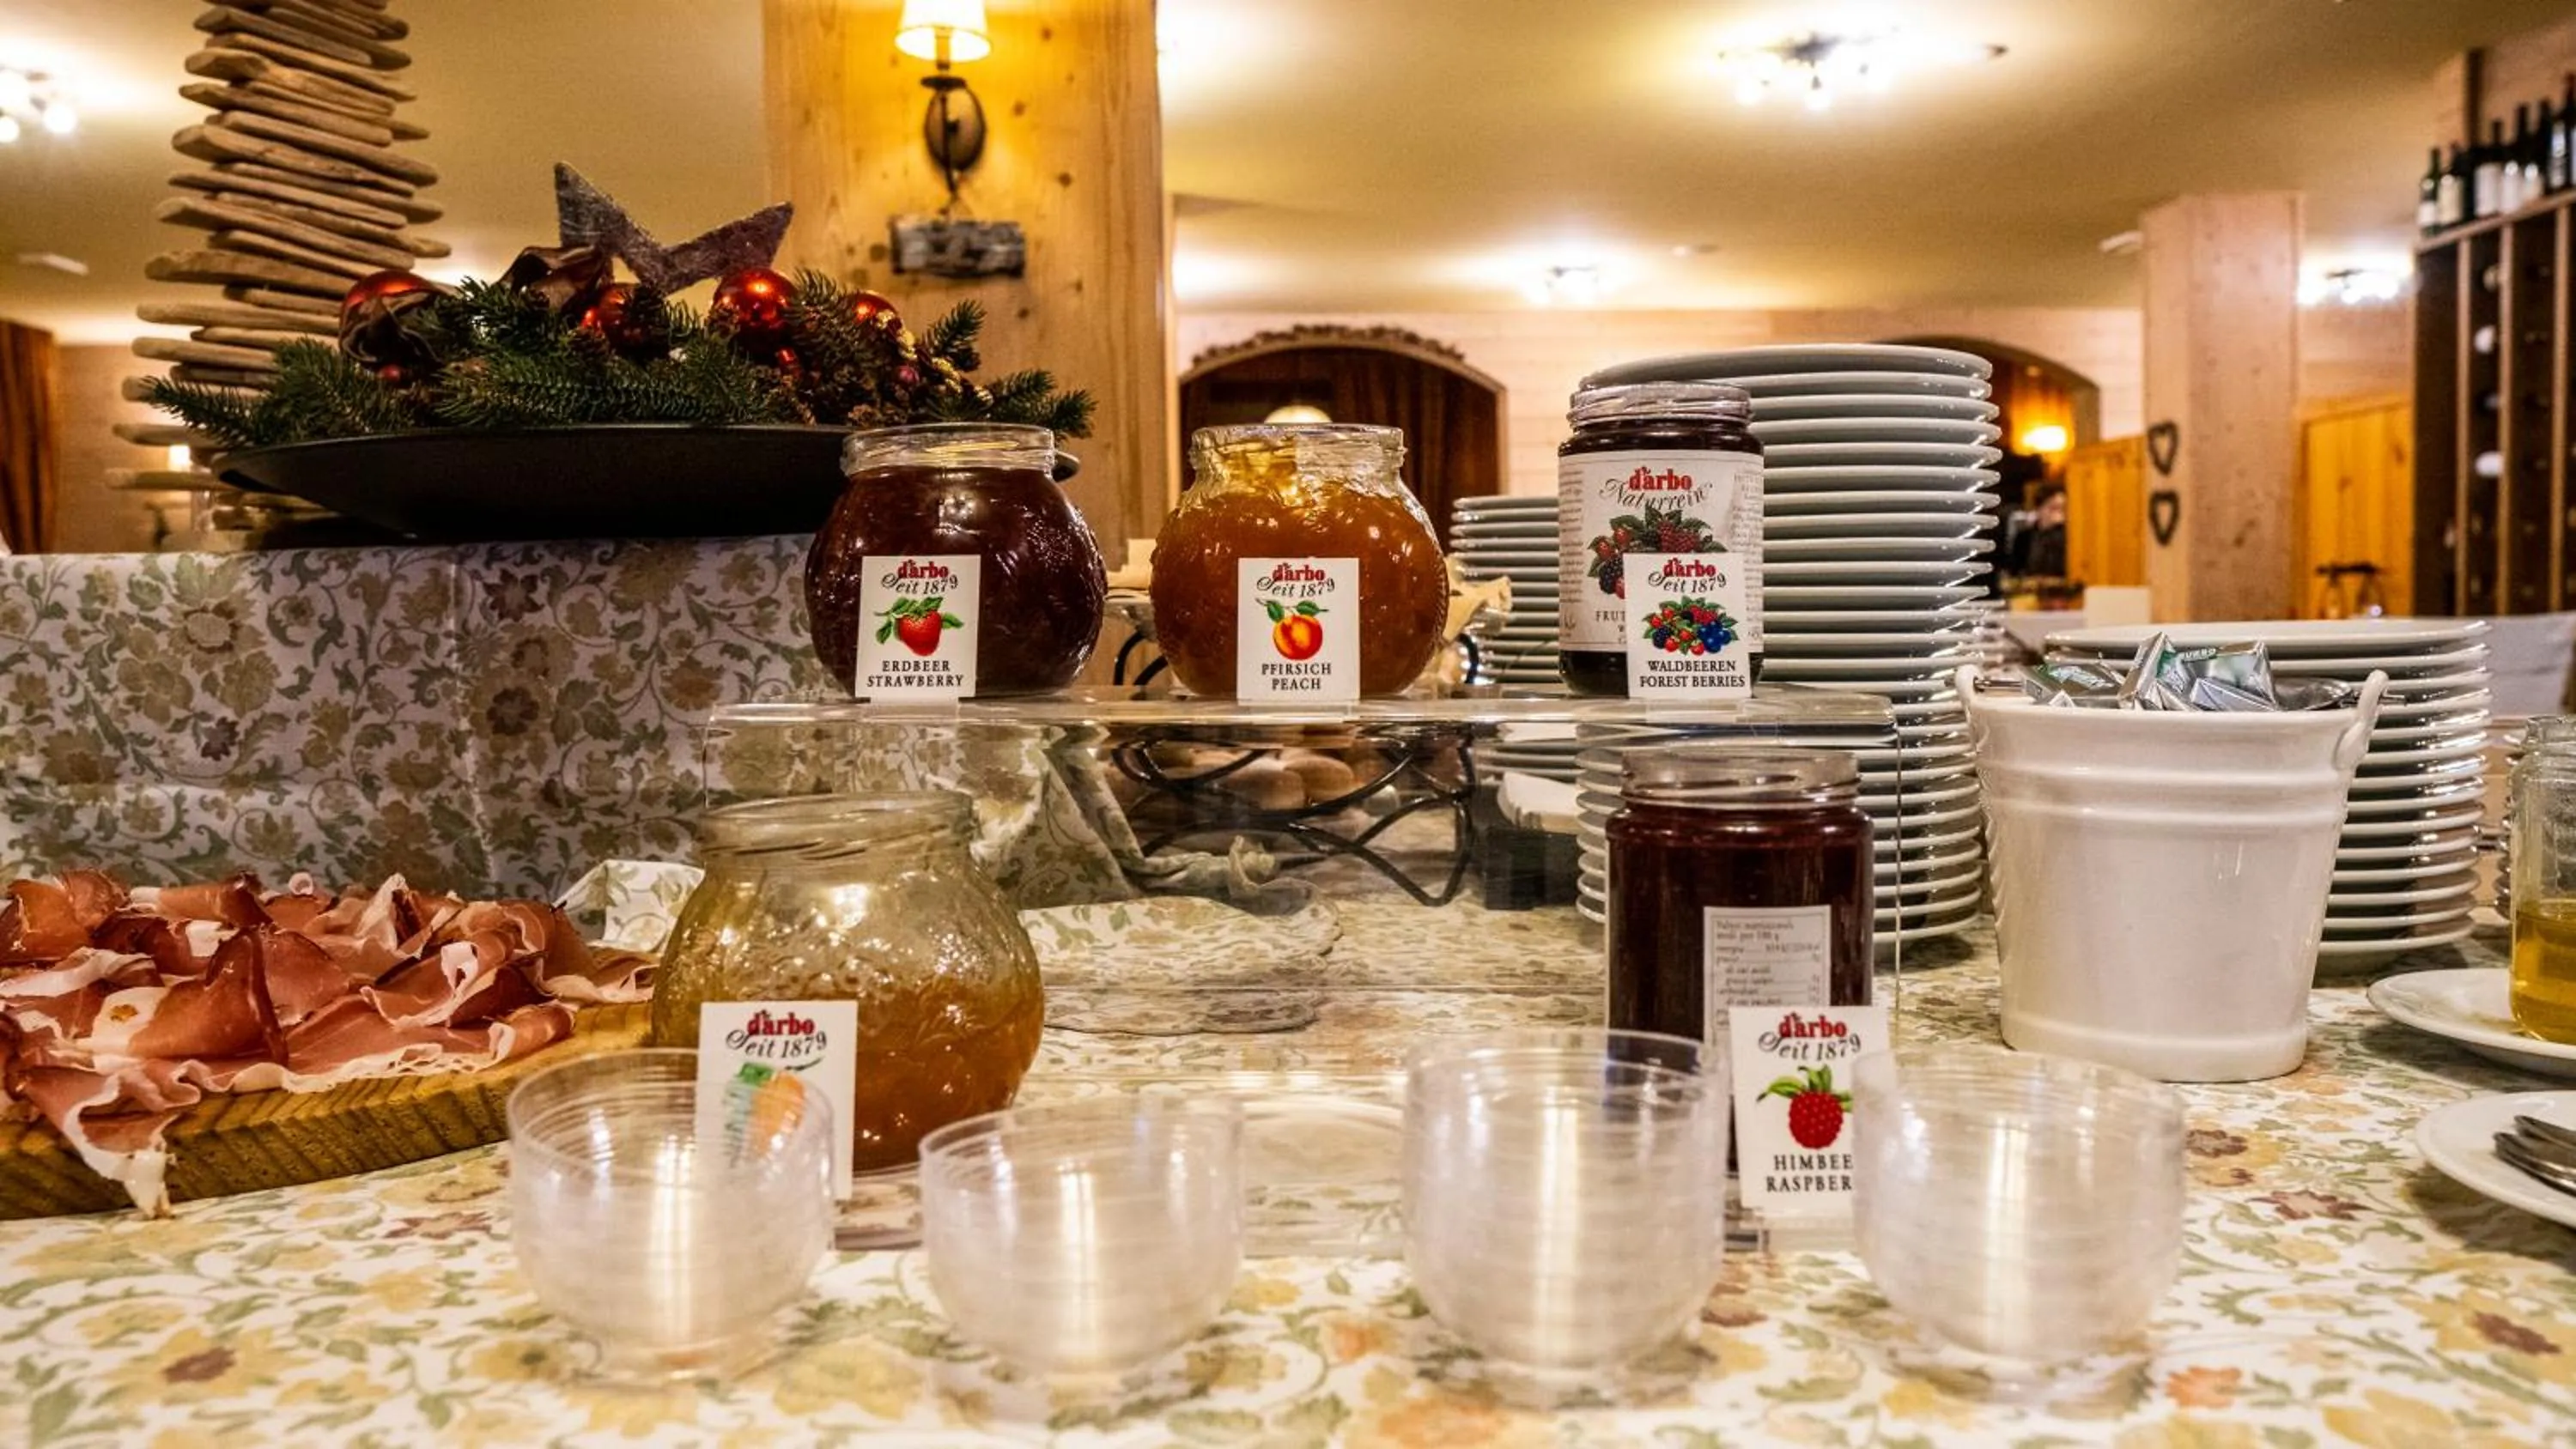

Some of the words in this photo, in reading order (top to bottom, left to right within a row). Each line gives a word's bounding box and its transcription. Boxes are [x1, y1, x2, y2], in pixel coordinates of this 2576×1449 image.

[881, 573, 920, 594] Seit
[923, 574, 959, 595] 1879
[1256, 576, 1294, 597] Seit
[1299, 578, 1335, 598] 1879
[1648, 572, 1685, 592] Seit
[1692, 573, 1727, 593] 1879
[1595, 610, 1625, 622] FRUT
[882, 660, 951, 672] ERDBEER
[1261, 664, 1331, 676] PFIRSICH
[1647, 660, 1736, 672] WALDBEEREN
[866, 675, 964, 688] STRAWBERRY
[1272, 678, 1321, 690] PEACH
[1639, 676, 1688, 688] FOREST
[1692, 675, 1746, 688] BERRIES
[726, 1029, 776, 1058] Seit
[781, 1030, 827, 1058] 1879
[1759, 1031, 1809, 1060] Seit
[1816, 1033, 1862, 1061] 1879
[1773, 1155, 1853, 1171] HIMBEE
[1766, 1176, 1852, 1192] RASPBER
